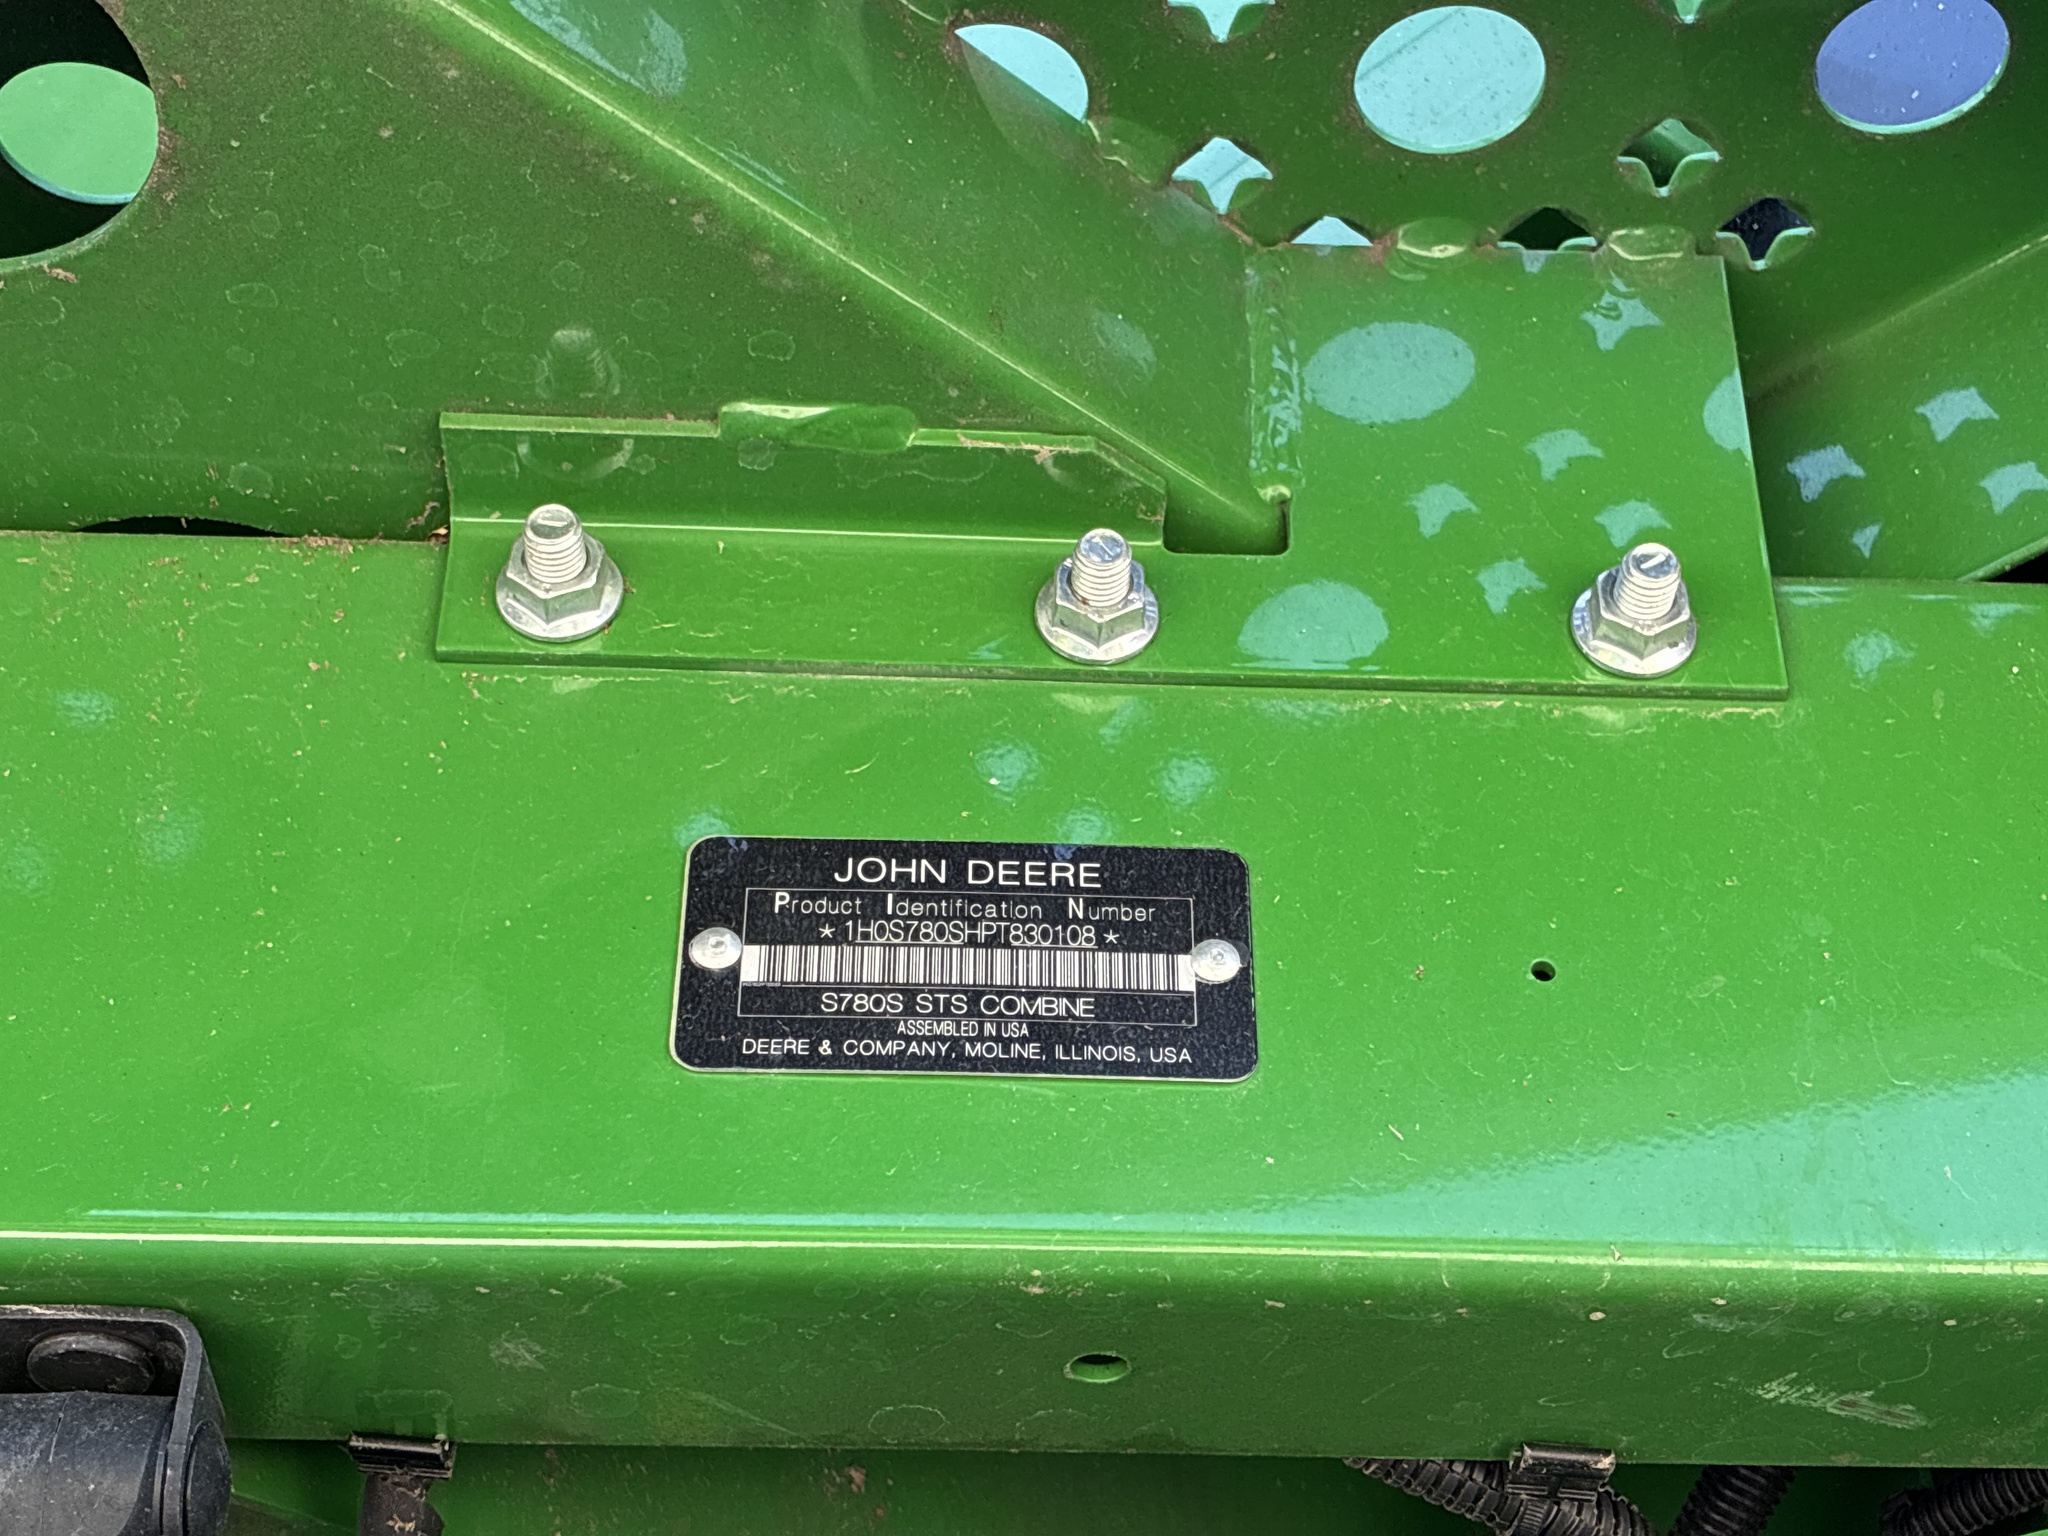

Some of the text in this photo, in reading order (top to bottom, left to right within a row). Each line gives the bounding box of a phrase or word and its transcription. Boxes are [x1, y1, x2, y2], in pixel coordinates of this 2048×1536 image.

[833, 857, 1101, 888] JOHN DEERE
[773, 892, 1156, 922] Product Identification Number
[821, 993, 1096, 1018] S780S STS COMBINE
[897, 1021, 1029, 1038] ASSEMBLED IN USA
[742, 1039, 1192, 1064] DEERE & COMPANY, MOLINE, ILLINOIS, USA
